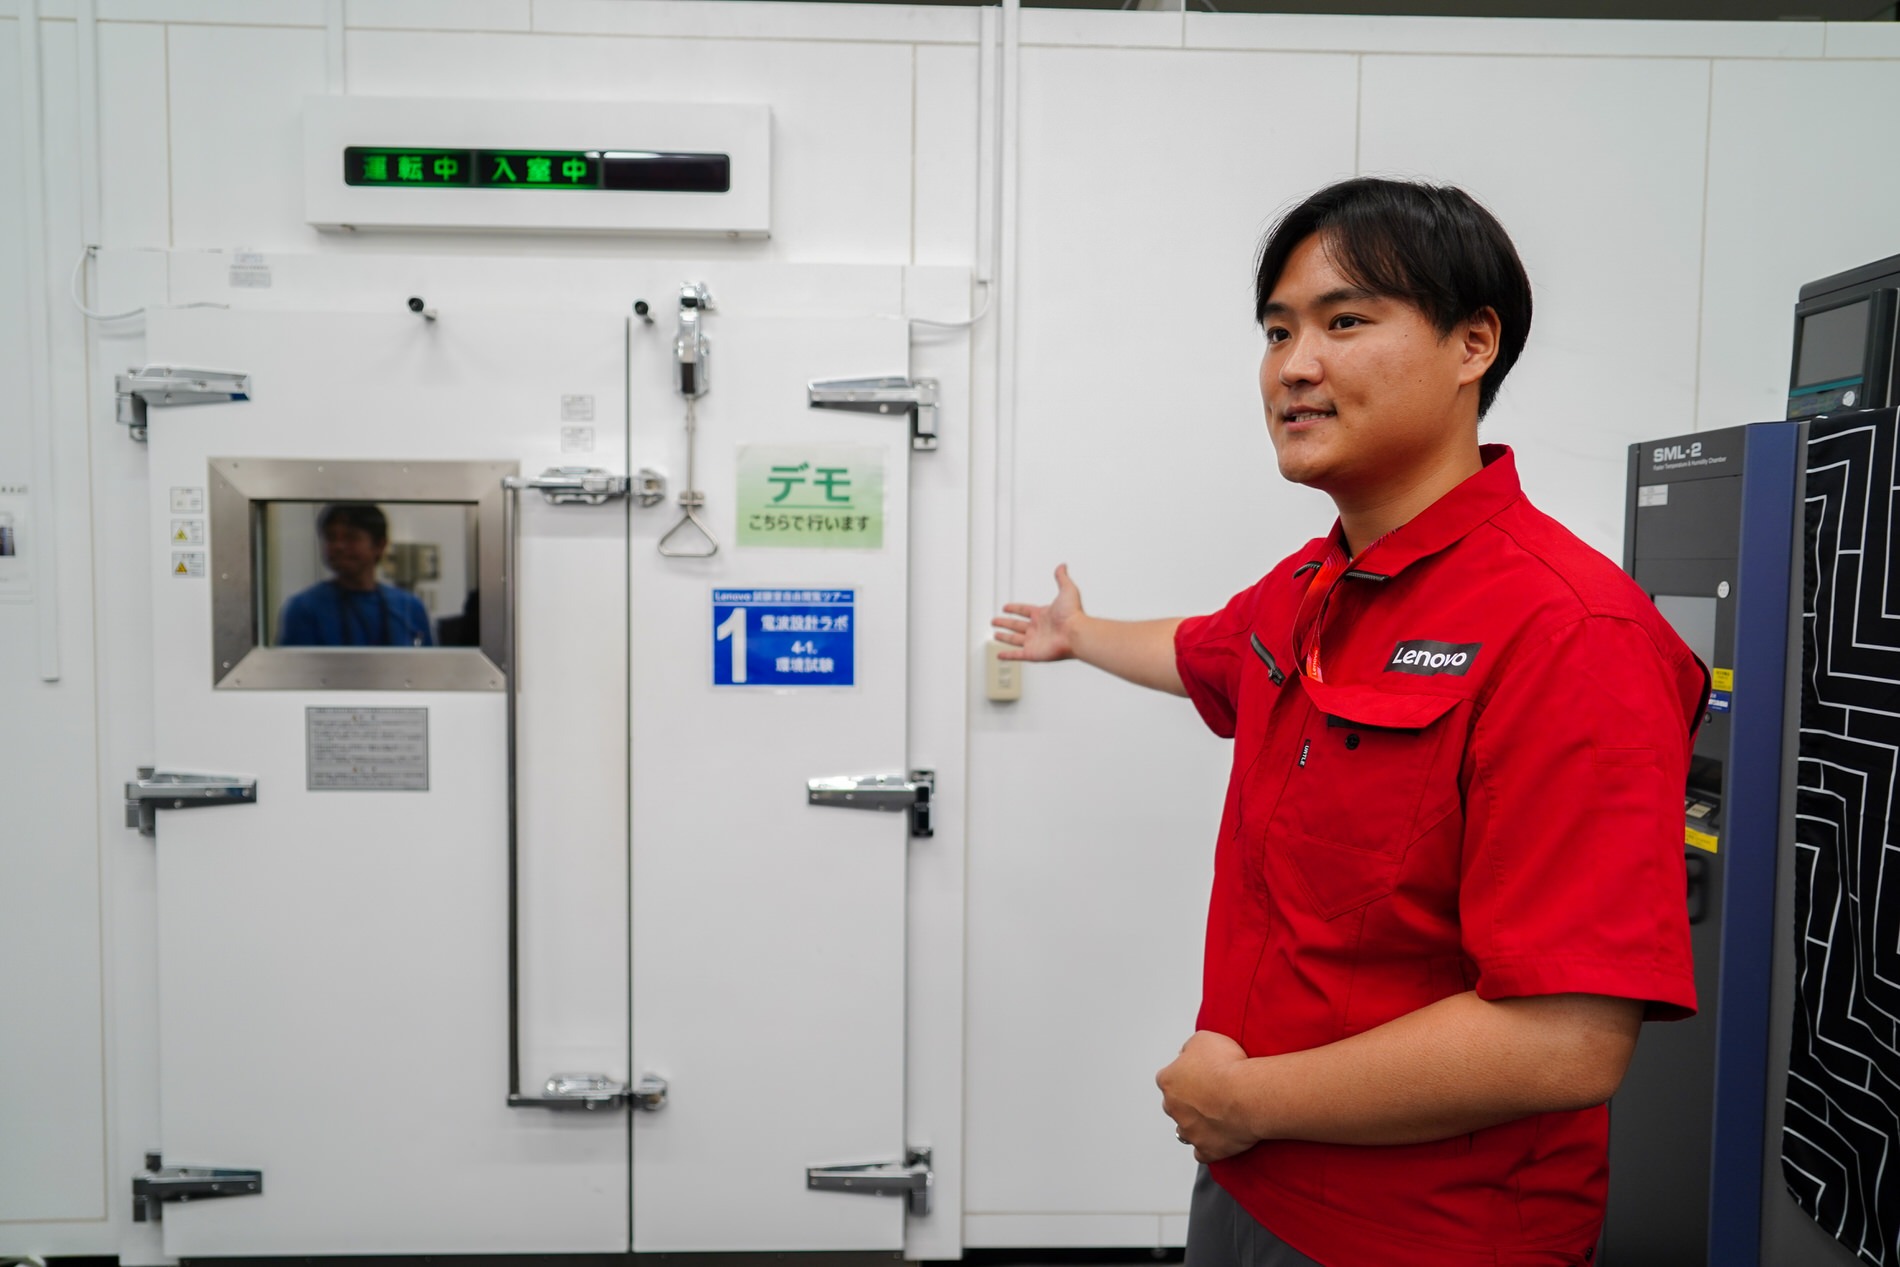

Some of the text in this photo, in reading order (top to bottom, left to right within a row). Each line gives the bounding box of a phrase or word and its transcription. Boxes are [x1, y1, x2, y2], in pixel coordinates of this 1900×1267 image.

[363, 155, 588, 183] 運転中 入室中
[767, 461, 851, 503] デモ
[749, 514, 869, 531] こちらで行います
[715, 591, 751, 602] Lenovo
[761, 614, 849, 631] 電波設計ラボ
[716, 607, 747, 683] 1
[775, 657, 834, 673] 環境試験
[1392, 647, 1467, 668] Lenovo
